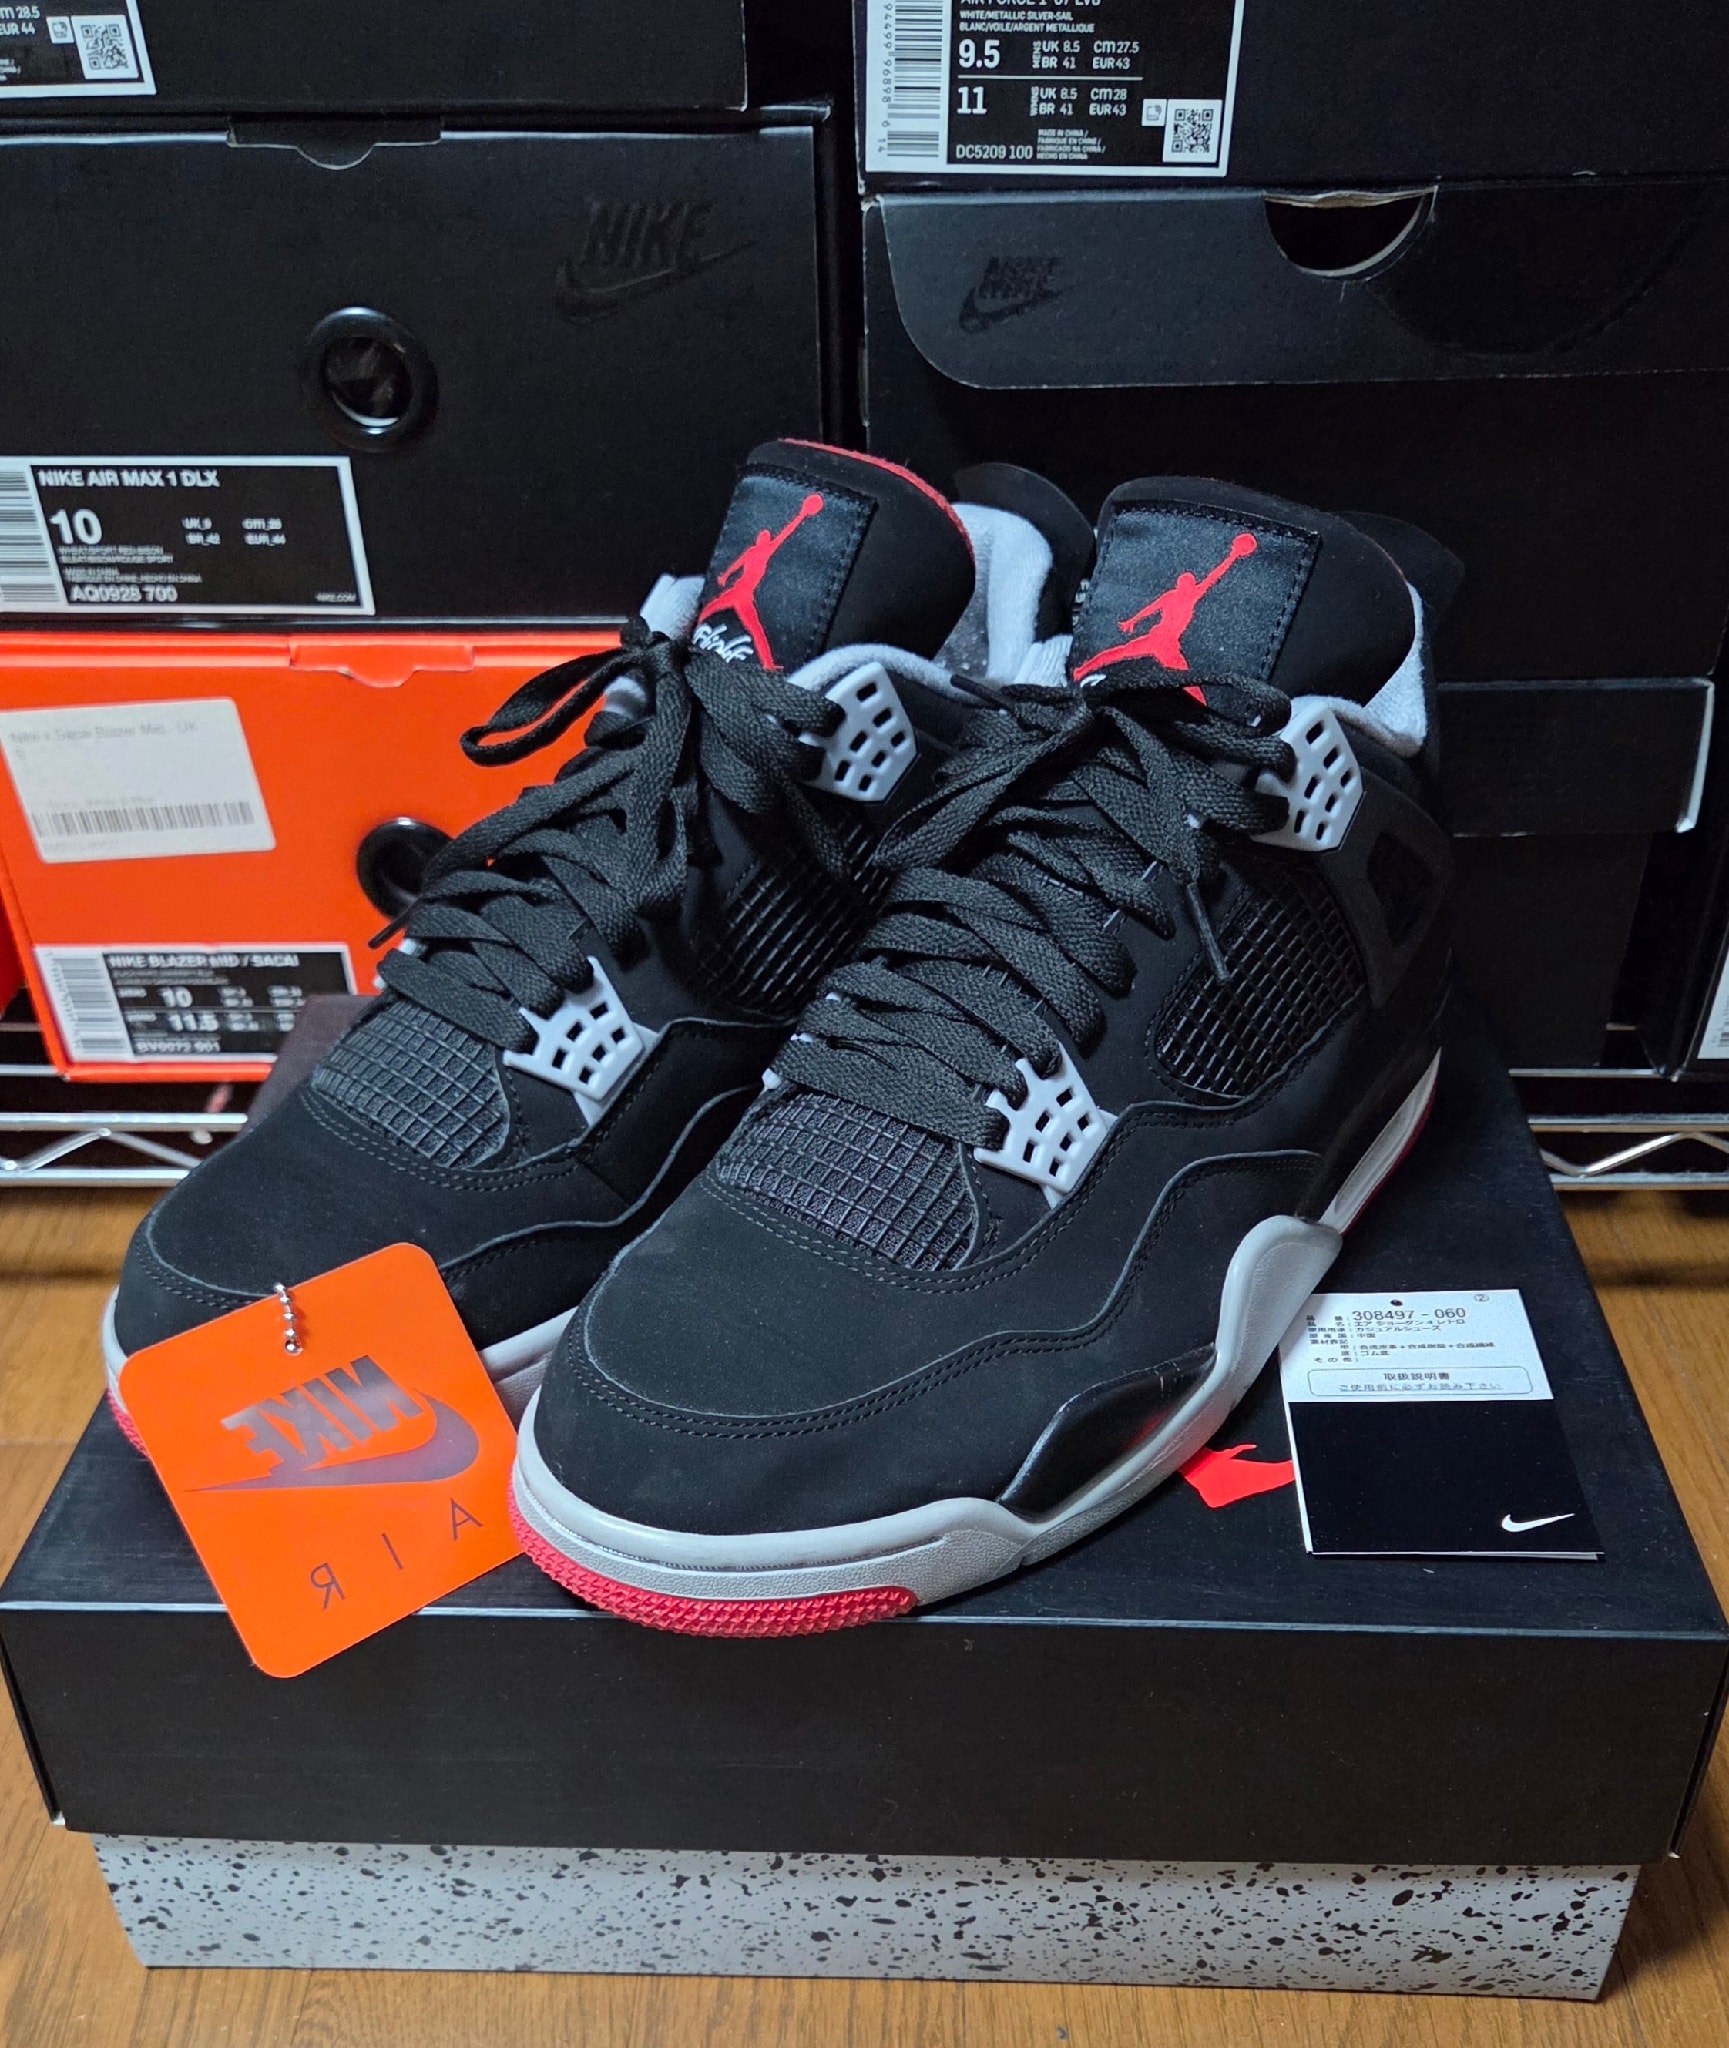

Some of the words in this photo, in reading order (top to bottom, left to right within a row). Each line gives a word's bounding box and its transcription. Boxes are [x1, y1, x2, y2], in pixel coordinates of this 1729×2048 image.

[0, 7, 15, 19] m
[1027, 10, 1074, 21] SILVER-SAIL
[958, 38, 1000, 69] 9.5
[1042, 40, 1059, 53] UK
[1062, 40, 1080, 53] 8.5
[1041, 56, 1058, 69] BR
[1062, 56, 1076, 69] 41
[957, 86, 987, 115] 11
[1040, 88, 1057, 100] UK
[1060, 88, 1077, 100] 8.5
[1038, 103, 1055, 115] BR
[1059, 103, 1074, 115] 41
[956, 145, 1007, 159] DC5209
[1009, 145, 1033, 159] 100
[38, 469, 85, 487] NIKE
[86, 469, 120, 487] AIR
[121, 469, 165, 487] MAX
[166, 469, 177, 487] 1
[180, 469, 220, 488] DLX
[50, 508, 103, 545] 10
[71, 585, 142, 602] AQ0928
[142, 585, 178, 602] 700
[108, 954, 147, 968] NIKE
[149, 954, 208, 968] BLAZER
[251, 953, 300, 967] SACAI
[159, 986, 193, 1008] 10
[1352, 1310, 1415, 1321] 308497
[1434, 1307, 1466, 1319] 060
